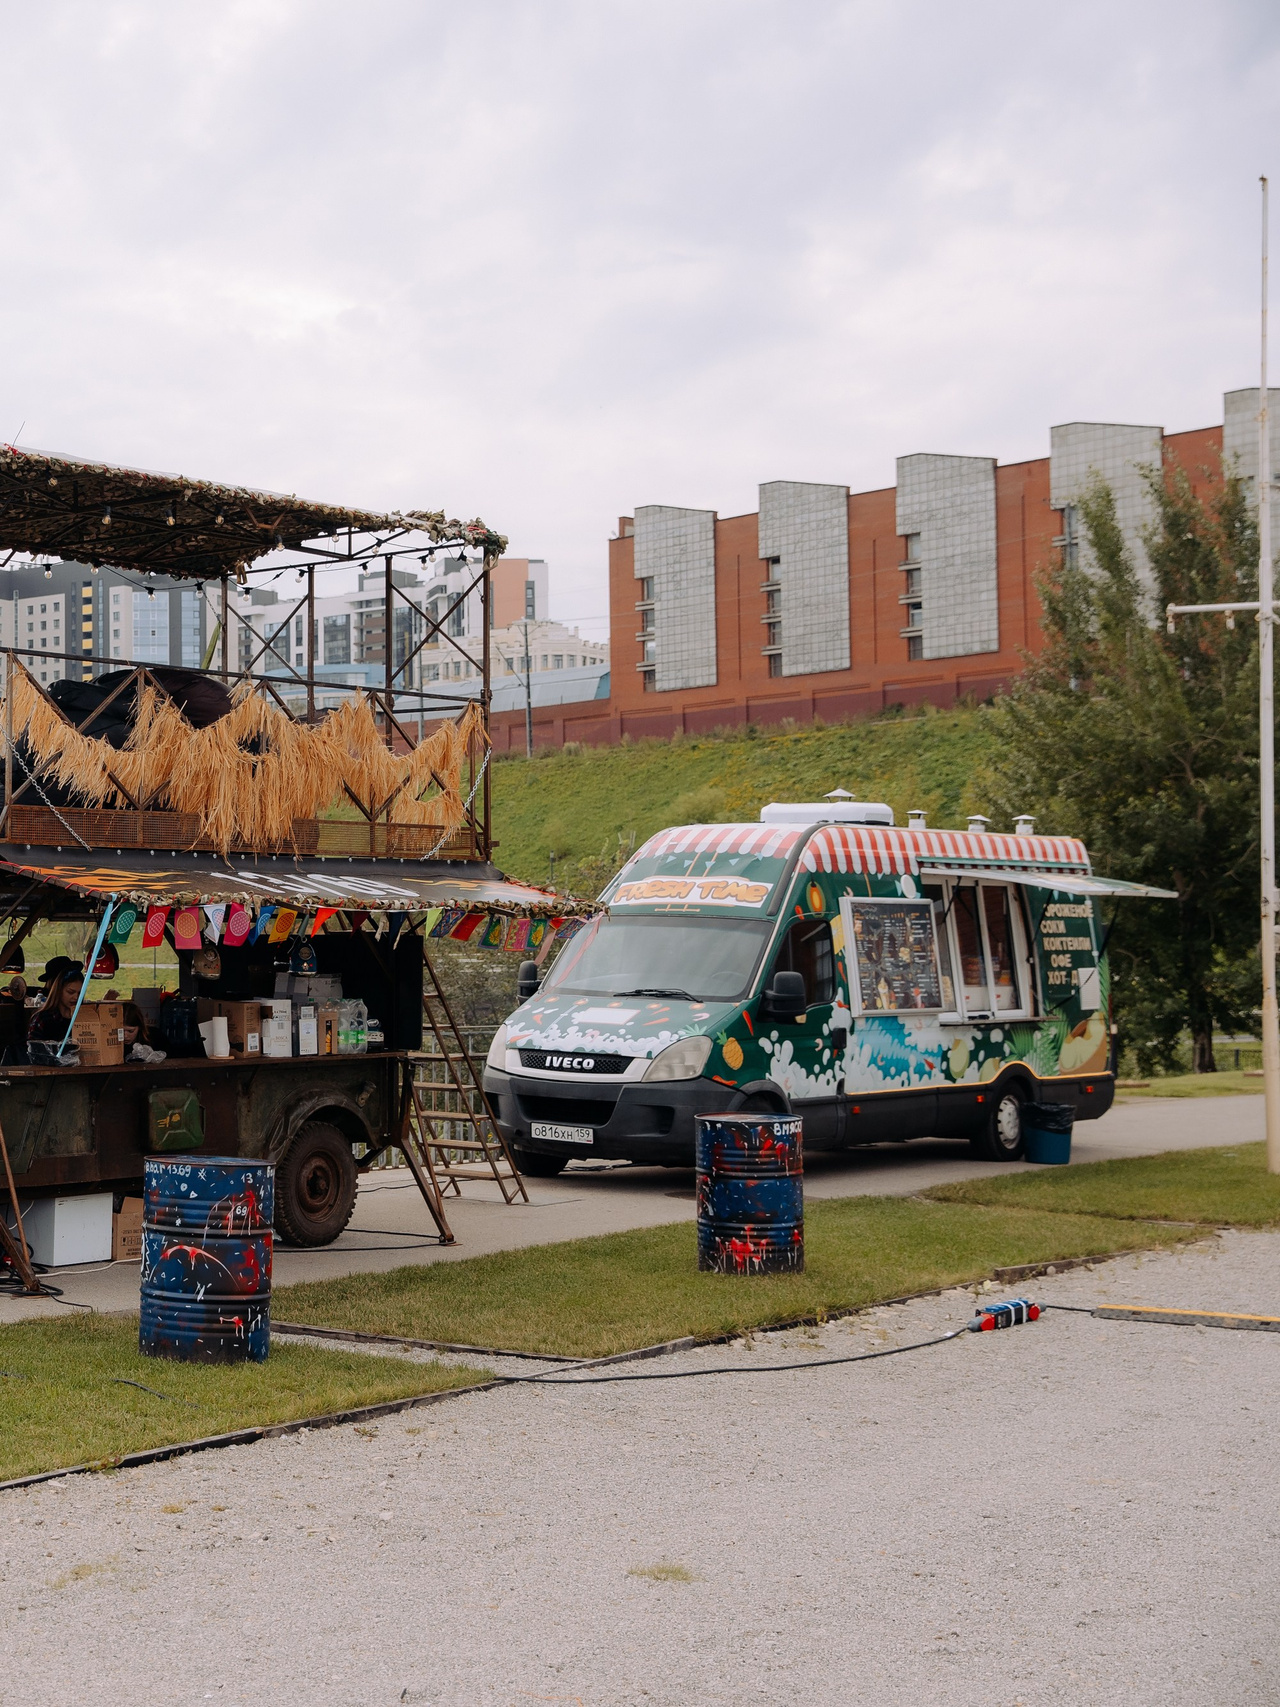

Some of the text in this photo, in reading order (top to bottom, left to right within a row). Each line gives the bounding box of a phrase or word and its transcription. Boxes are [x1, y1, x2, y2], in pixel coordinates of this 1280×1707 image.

[1040, 920, 1066, 934] СОКИ
[545, 1056, 595, 1070] IVECO
[575, 1128, 590, 1139] 159
[241, 1173, 254, 1184] 13
[235, 1206, 248, 1216] 69
